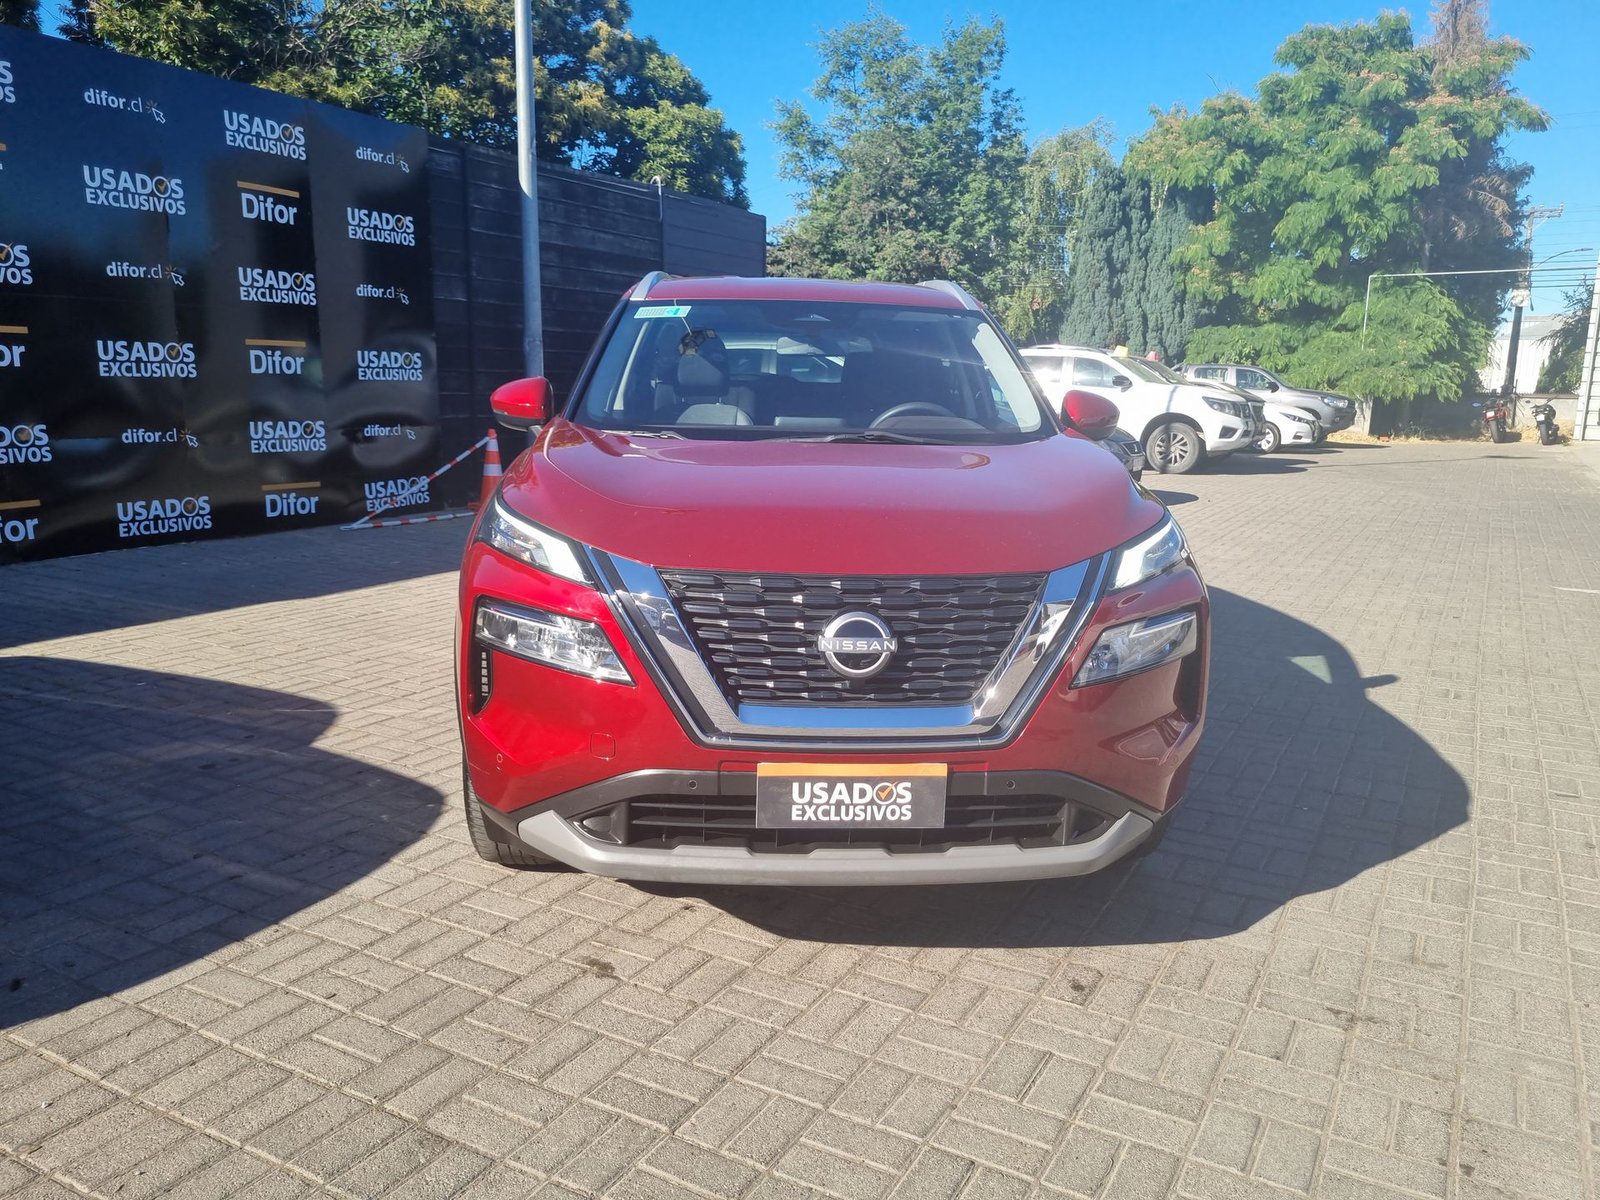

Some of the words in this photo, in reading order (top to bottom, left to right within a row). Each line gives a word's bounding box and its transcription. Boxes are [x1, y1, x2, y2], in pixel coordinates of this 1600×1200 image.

[84, 88, 142, 112] difor.cl
[224, 110, 305, 145] USADOS
[226, 130, 307, 161] EXCLUSIVOS
[356, 147, 395, 165] difor.cl
[83, 165, 184, 199] USADOS
[86, 187, 186, 215] EXCLUSIVOS
[241, 192, 298, 225] Difor
[347, 207, 414, 233] USADOS
[348, 225, 415, 246] EXCLUSIVOS
[106, 261, 162, 279] difor.cl
[238, 267, 316, 291] USADOS
[240, 286, 317, 305] EXCLUSIVOS
[356, 284, 395, 298] difor.cl
[97, 339, 195, 363] USADOS
[250, 350, 304, 374] Difor
[357, 350, 422, 369] USADOS
[99, 361, 197, 378] EXCLUSIVOS
[358, 367, 423, 381] EXCLUSIVOS
[121, 428, 177, 443] difor.cl
[250, 420, 326, 439] USADOS
[364, 424, 401, 437] difor.cl
[251, 438, 327, 453] EXCLUSIVOS
[364, 476, 429, 499] USADOS
[117, 496, 211, 522] USADOS
[265, 493, 319, 518] Difor
[118, 515, 212, 538] EXCLUSIVOS
[820, 640, 896, 651] NISSAN
[792, 781, 912, 804] USADOS
[791, 805, 912, 821] EXCLUSIVOS
